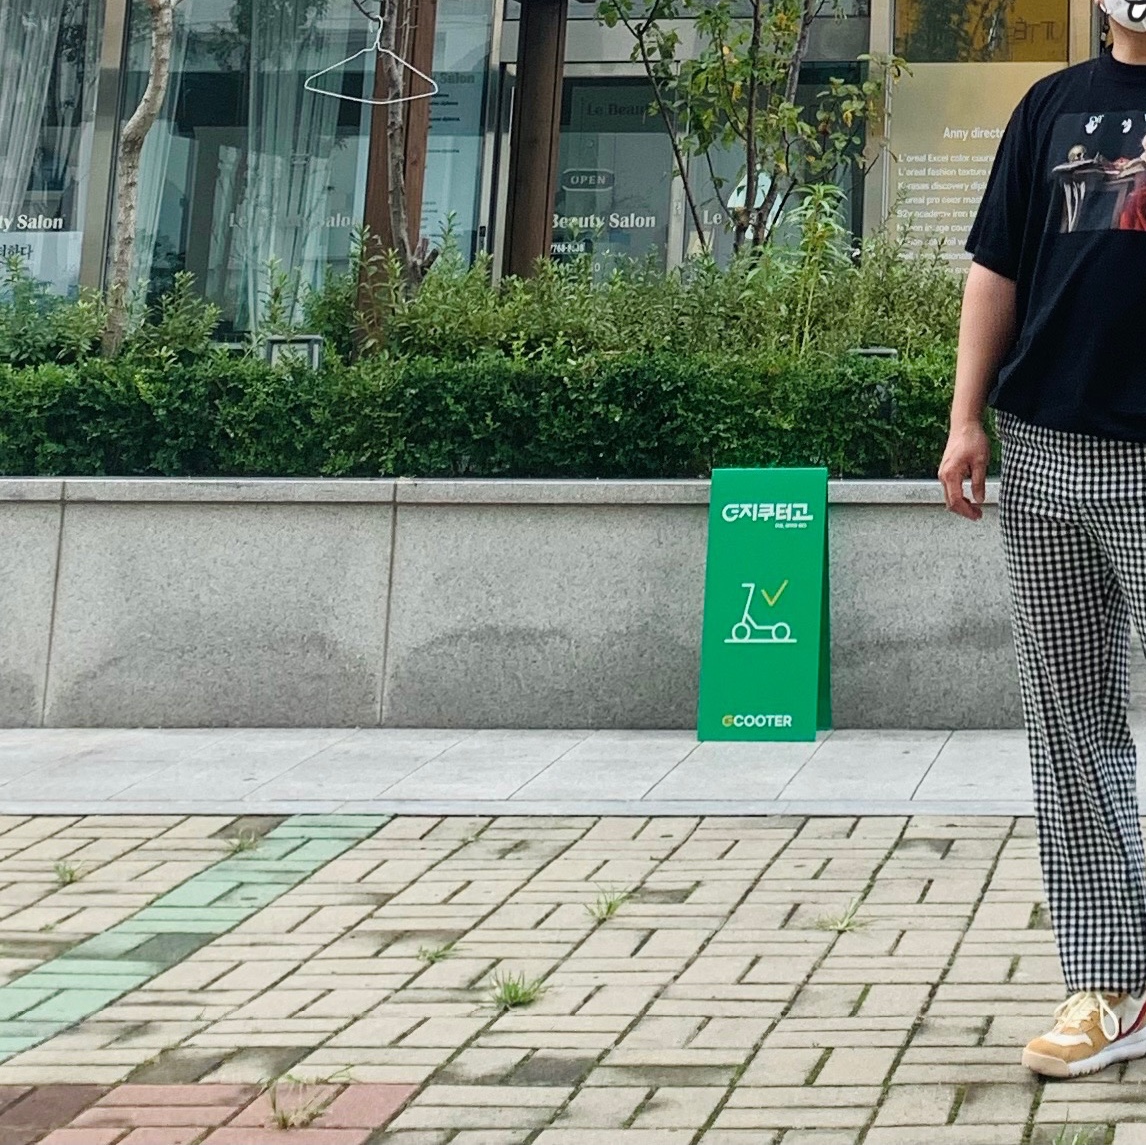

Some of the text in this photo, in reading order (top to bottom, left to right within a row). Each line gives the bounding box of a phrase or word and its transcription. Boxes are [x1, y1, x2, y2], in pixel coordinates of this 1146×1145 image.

[943, 127, 969, 141] Anny
[570, 174, 606, 186] OPEN
[17, 214, 63, 230] Salon
[609, 212, 656, 229] Salon
[703, 210, 722, 225] Le
